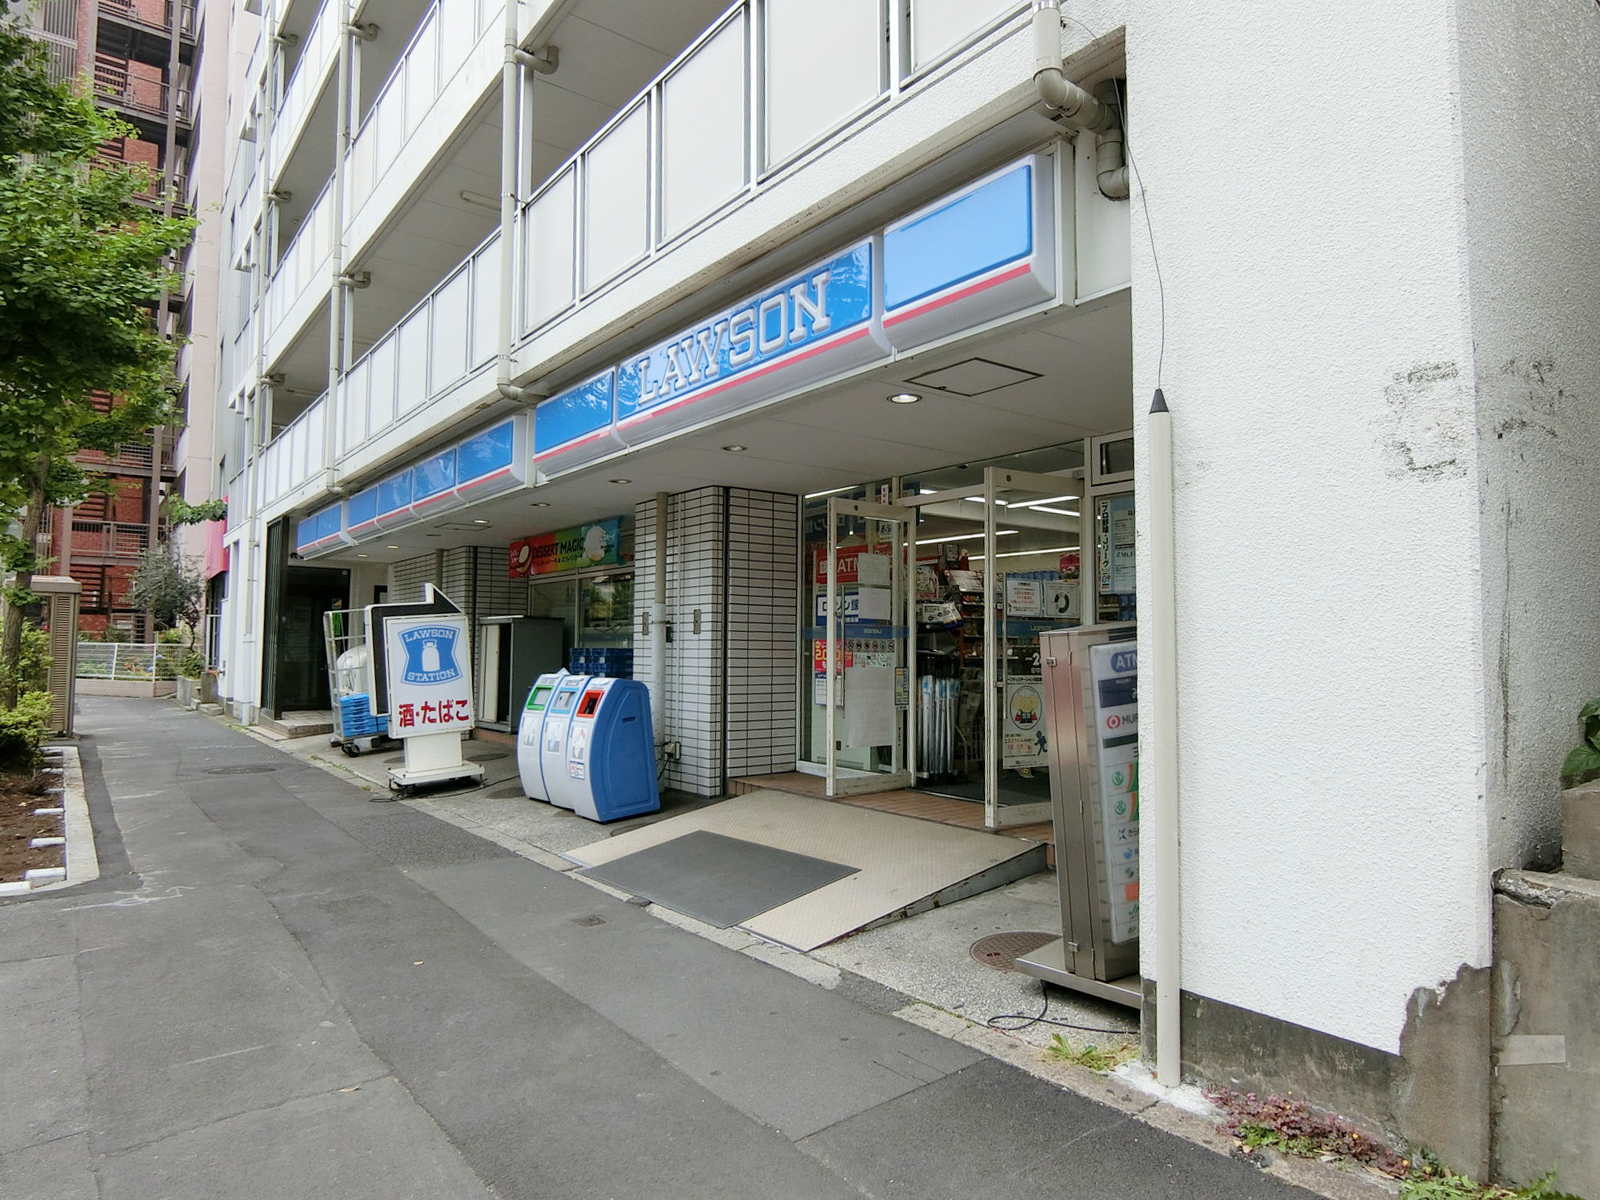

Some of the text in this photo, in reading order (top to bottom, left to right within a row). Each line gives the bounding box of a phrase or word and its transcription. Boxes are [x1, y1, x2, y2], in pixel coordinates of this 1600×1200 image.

[638, 271, 831, 405] LAWSON
[560, 537, 584, 554] MAGIC
[404, 629, 454, 642] LAWSON
[407, 668, 455, 682] STATION
[398, 698, 470, 728] 酒・たばこ
